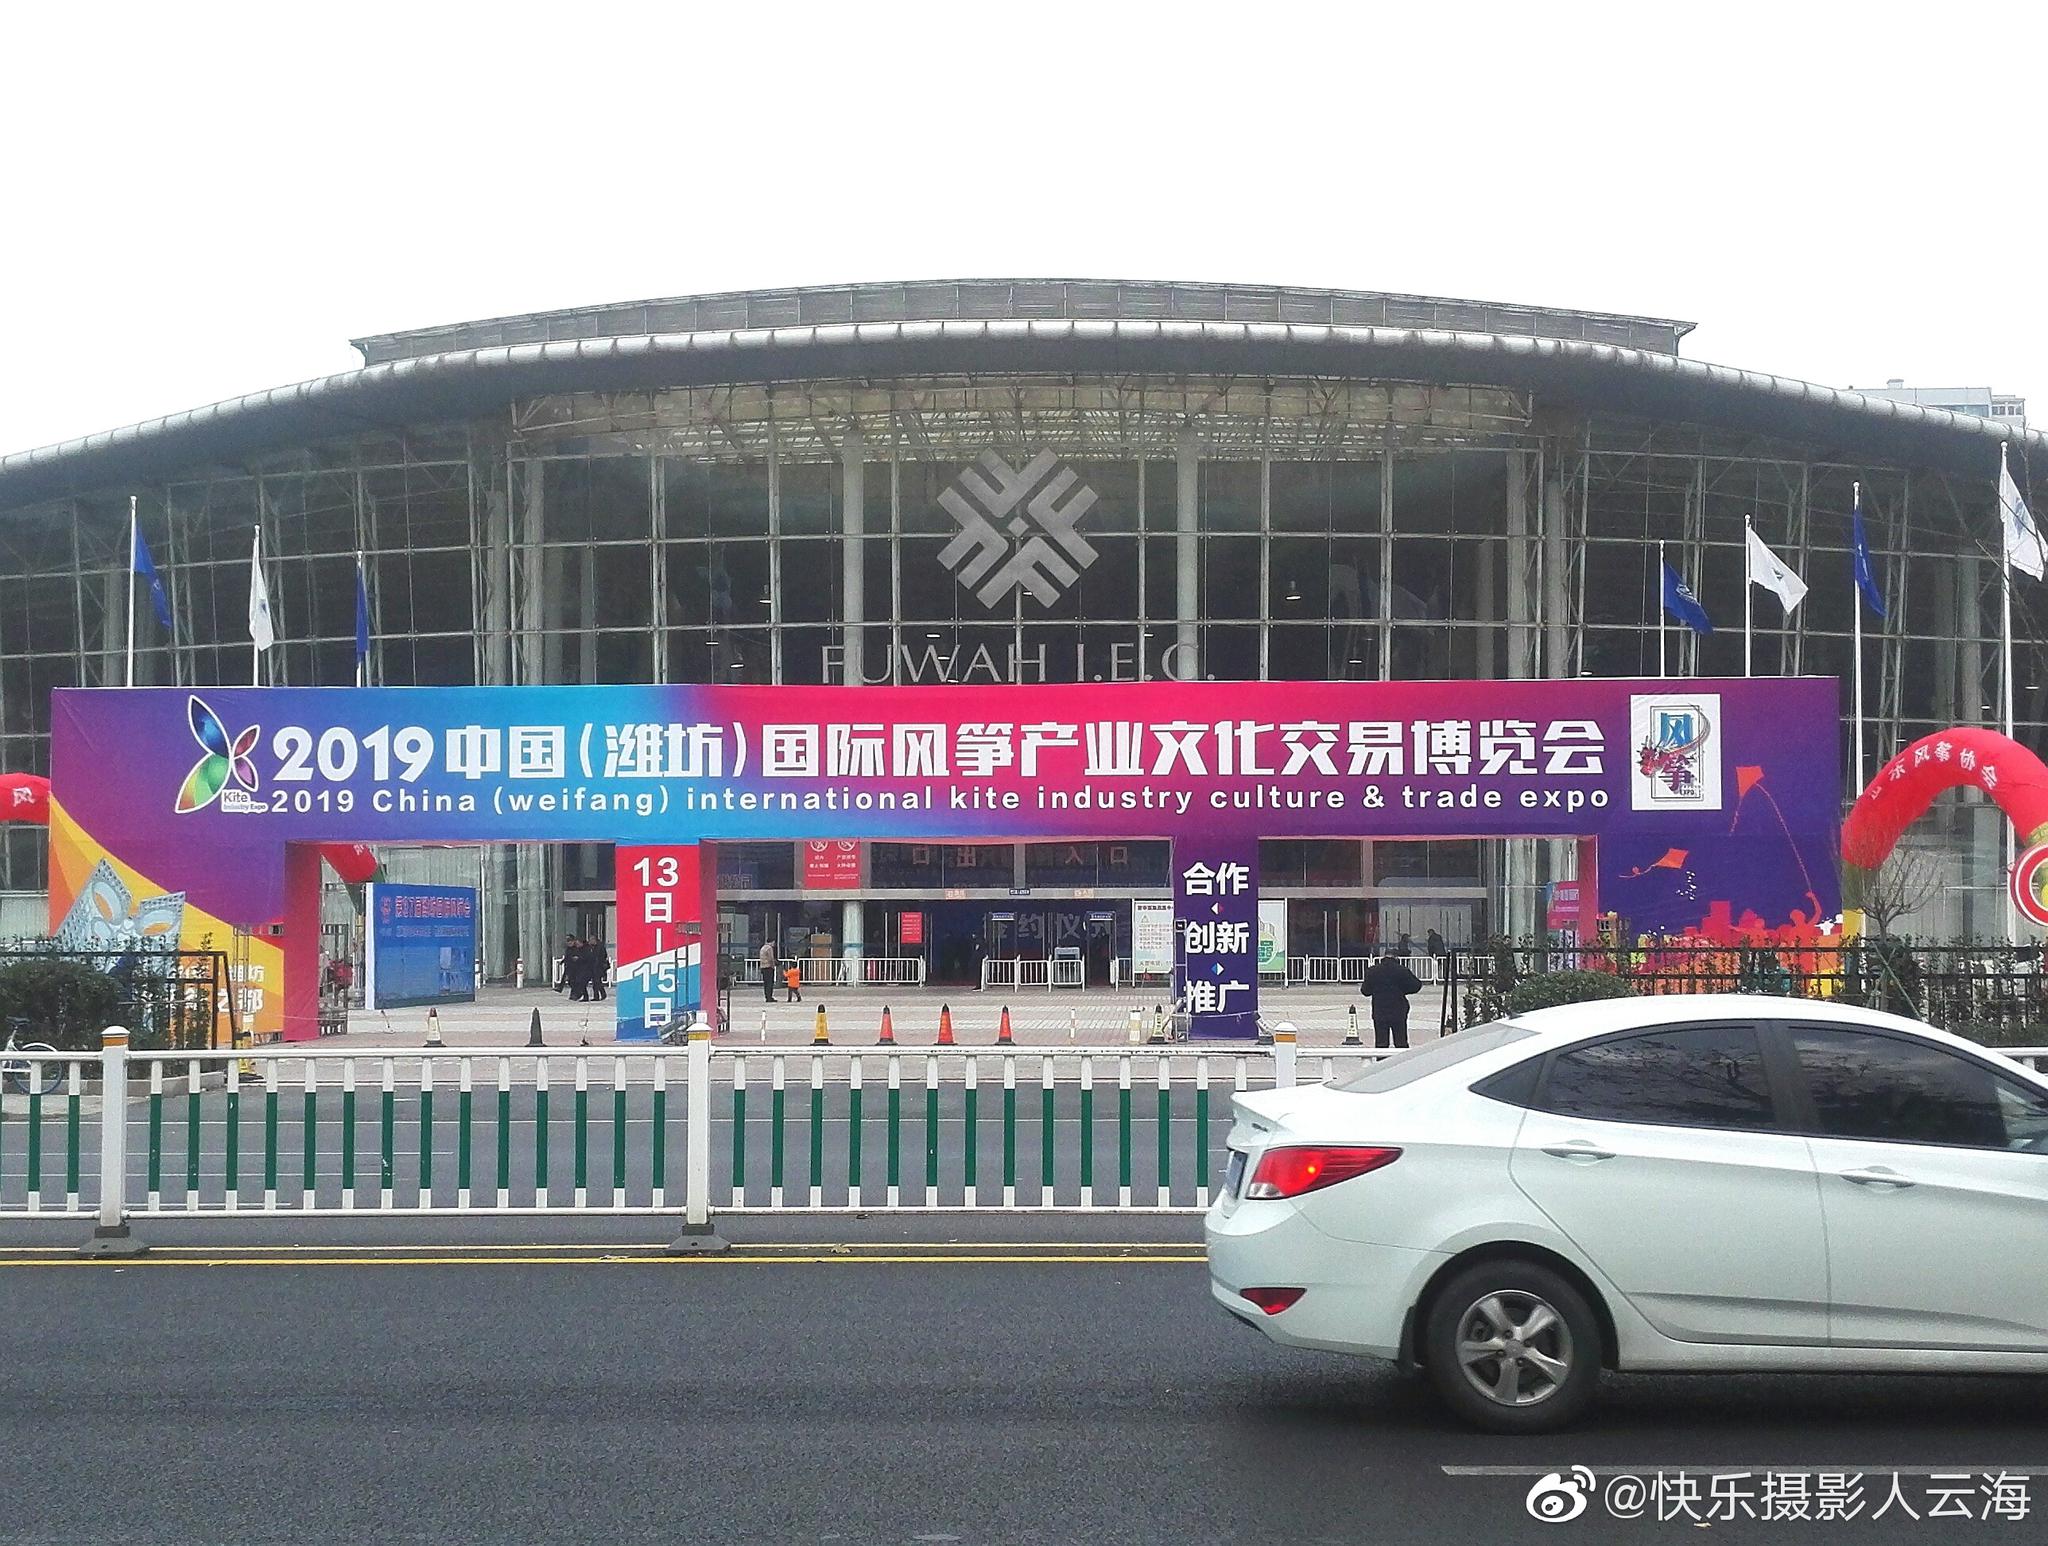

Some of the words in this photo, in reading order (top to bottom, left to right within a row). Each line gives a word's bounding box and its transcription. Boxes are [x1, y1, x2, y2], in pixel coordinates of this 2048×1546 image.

[820, 642, 1047, 684] FUWAH
[1076, 642, 1215, 683] I.E.C.
[224, 791, 248, 803] Kite
[250, 803, 266, 811] Expo
[271, 789, 354, 813] 2019
[372, 788, 475, 812] China
[493, 786, 668, 816] (weifang)
[687, 786, 931, 810] international
[950, 785, 1019, 809] kite
[1038, 785, 1192, 814] industry
[1210, 784, 1344, 808] culture
[1363, 785, 1386, 808] &
[1402, 784, 1502, 808] trade
[1520, 789, 1608, 813] expo
[1183, 862, 1250, 897] 合作
[1184, 920, 1250, 955] 创新
[1183, 980, 1250, 1014] 推广
